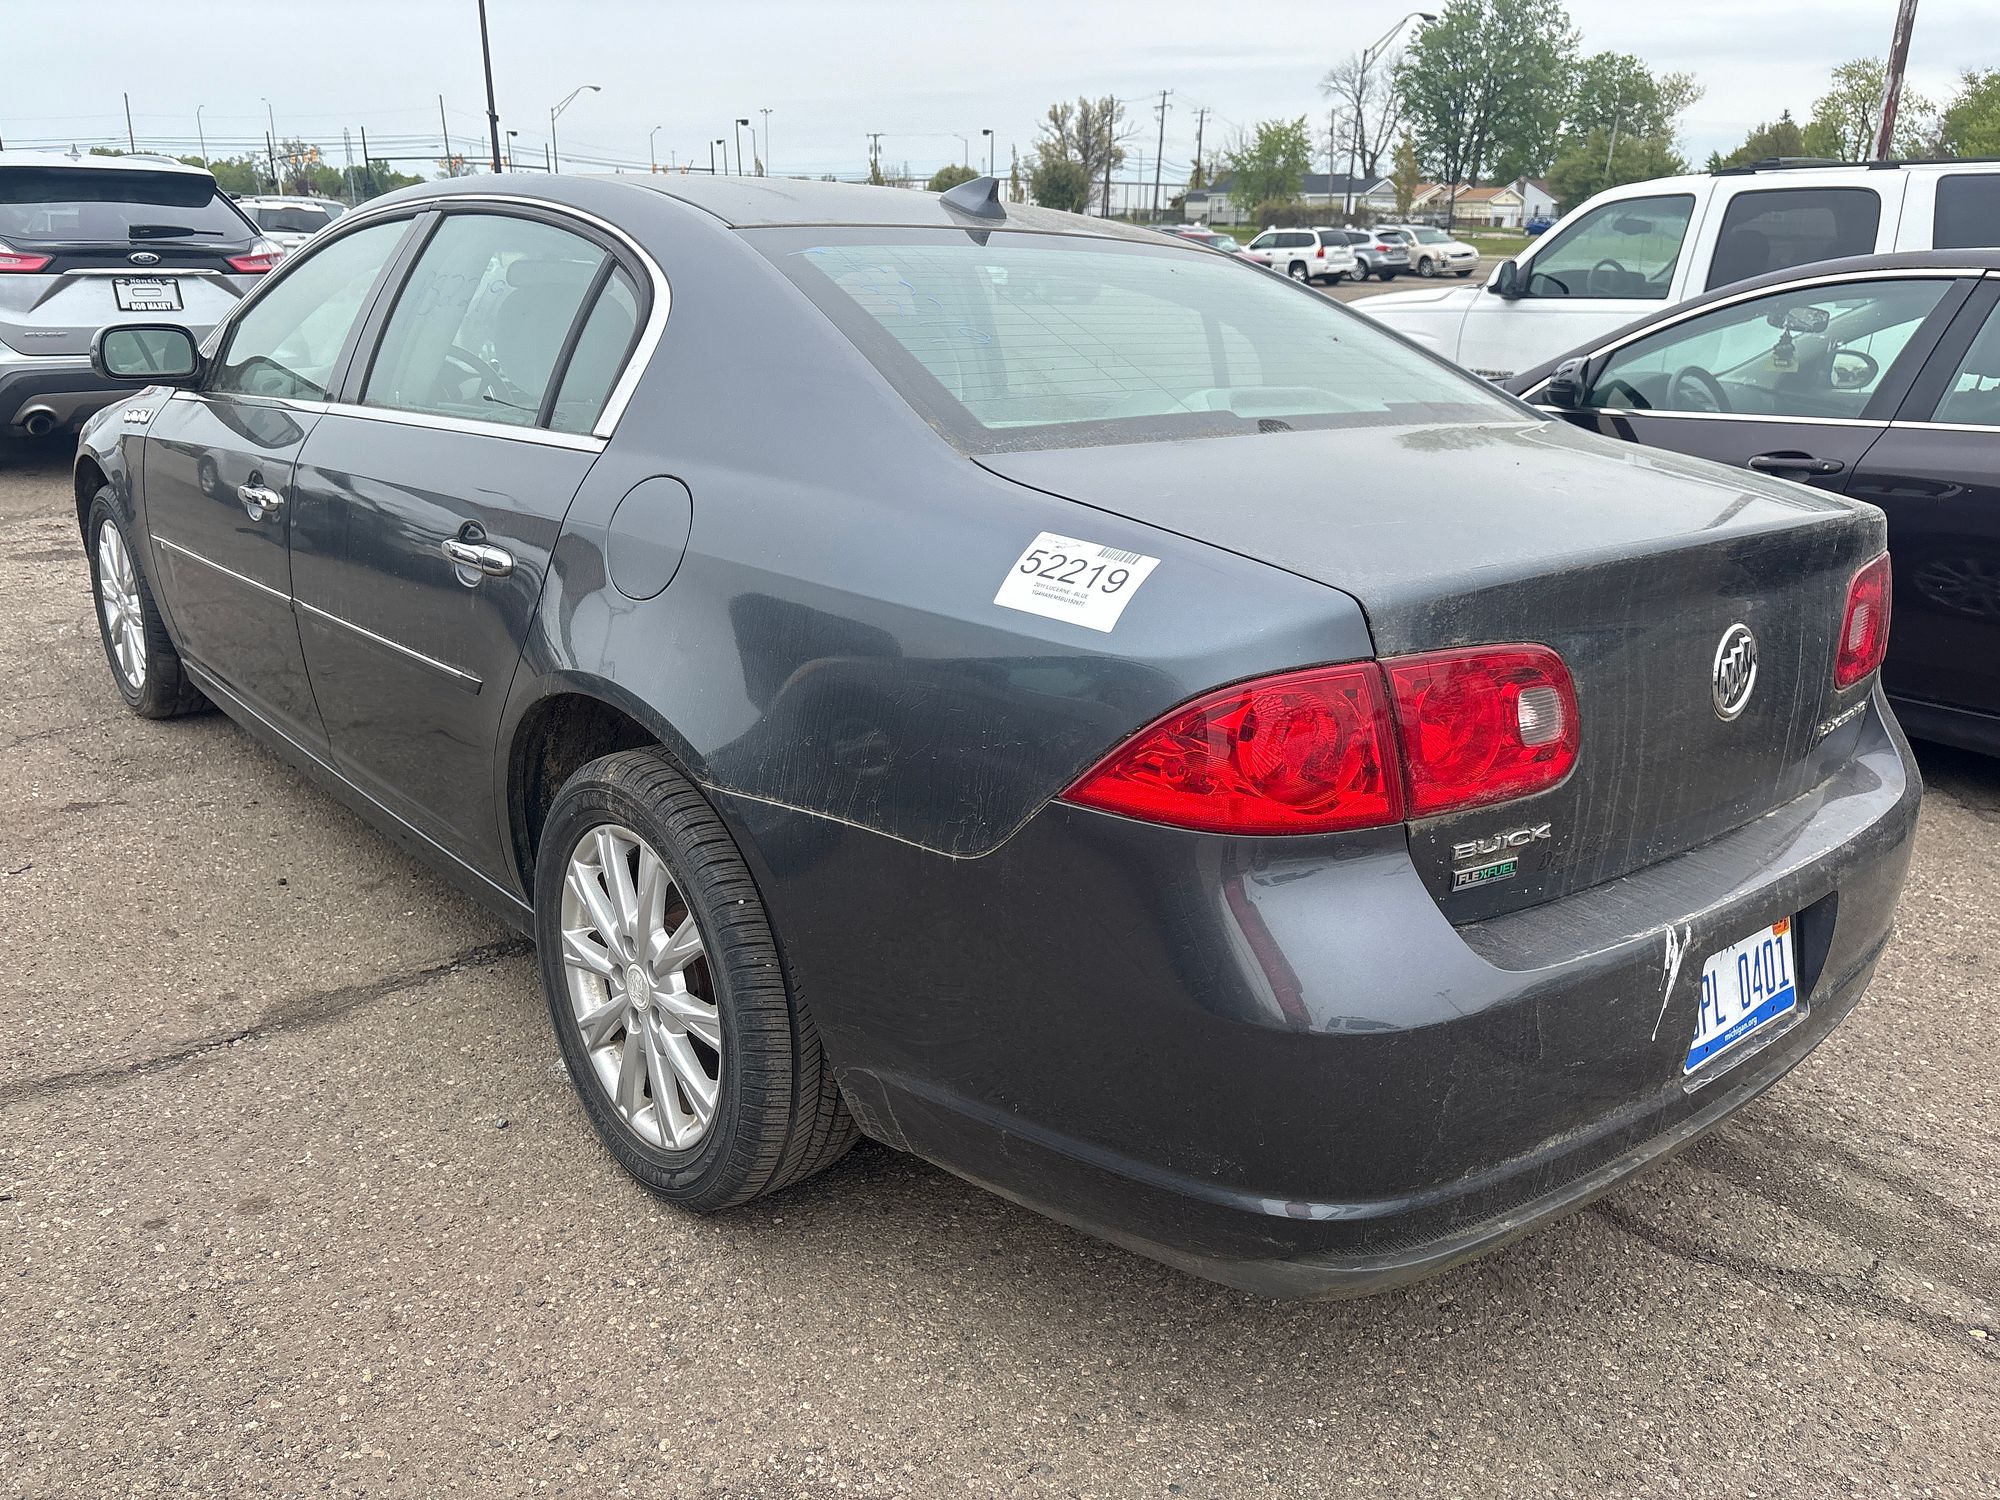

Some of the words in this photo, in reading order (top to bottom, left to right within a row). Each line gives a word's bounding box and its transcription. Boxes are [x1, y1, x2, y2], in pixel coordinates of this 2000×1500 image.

[131, 302, 146, 310] BOB
[146, 302, 171, 310] MAXEY
[1020, 549, 1129, 593] 52219
[1046, 584, 1071, 595] LUCERNE
[1073, 591, 1089, 599] BLUE
[1452, 823, 1551, 860] BUICK
[1458, 862, 1516, 884] FLEXFUEL
[1738, 936, 1789, 1010] 0401
[1724, 1016, 1758, 1042] michigan.org
